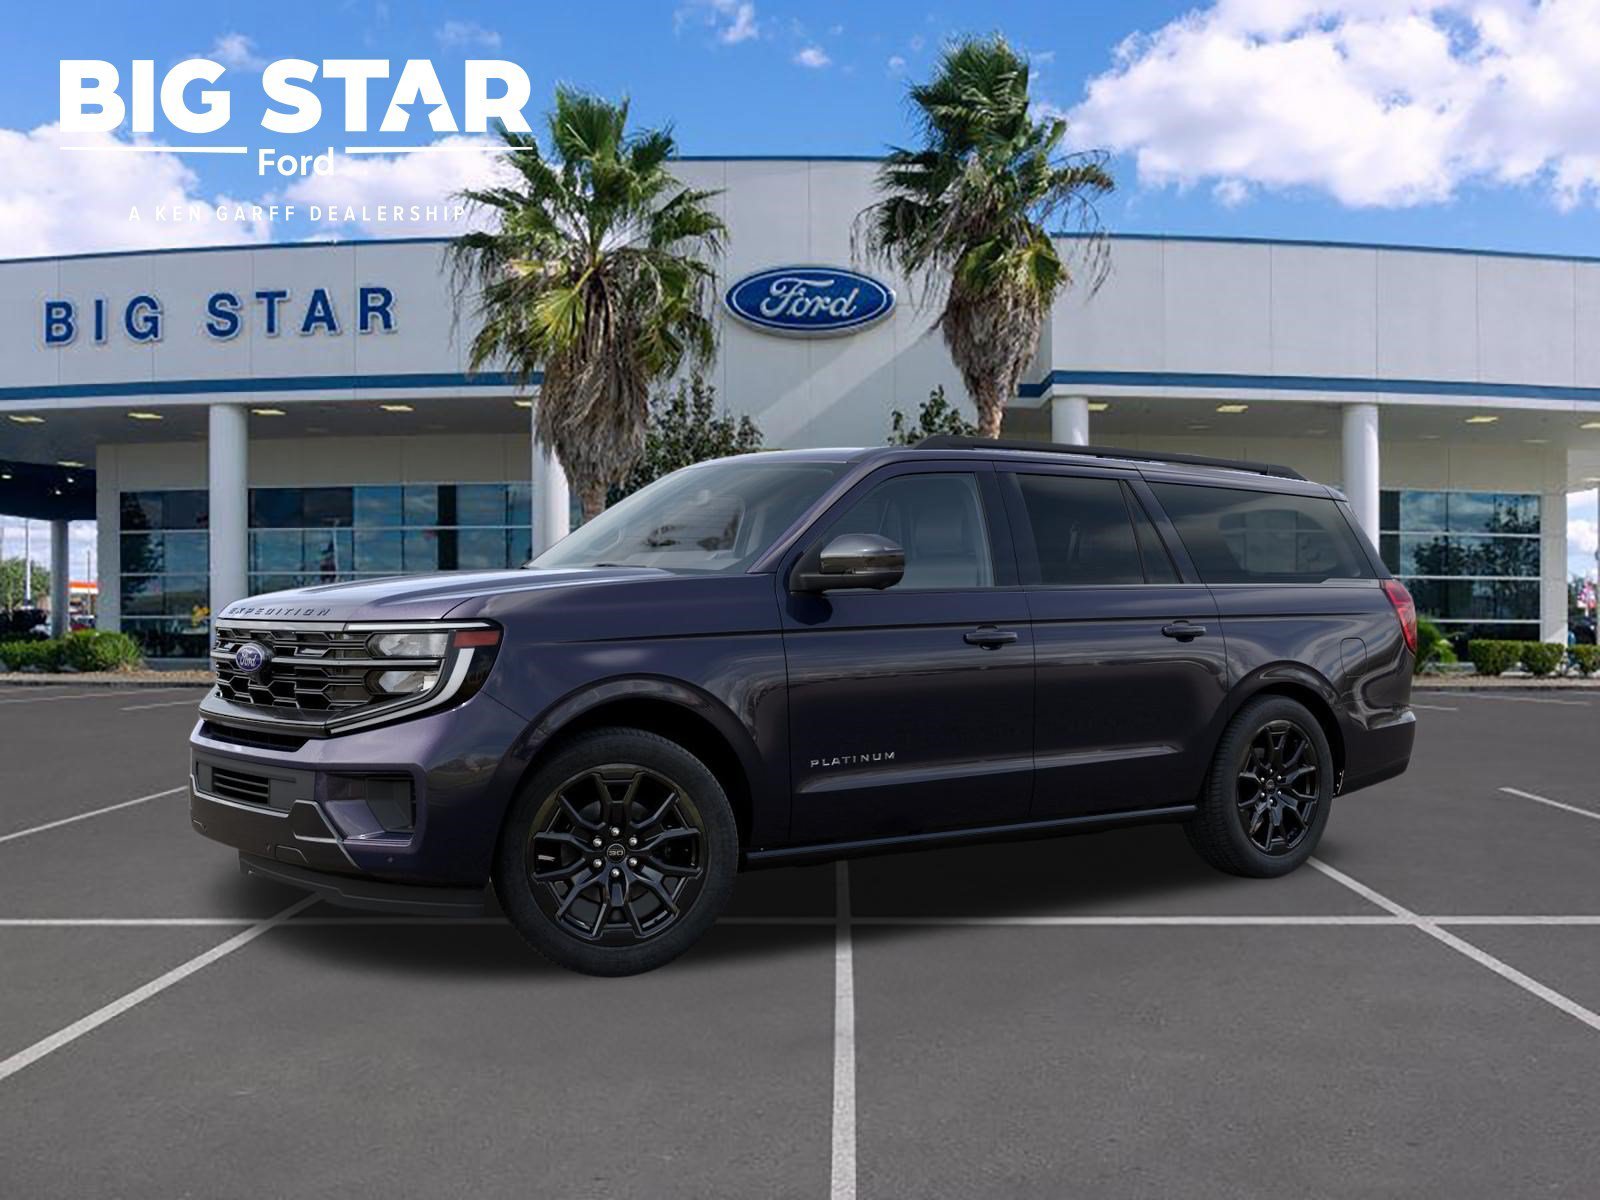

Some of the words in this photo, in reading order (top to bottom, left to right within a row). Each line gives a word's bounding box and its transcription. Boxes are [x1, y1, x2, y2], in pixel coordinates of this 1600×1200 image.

[759, 277, 860, 318] Ford
[44, 295, 163, 346] BIG
[206, 286, 397, 339] STAR
[228, 606, 332, 617] EXPEDITION
[810, 751, 896, 768] PLATINUM
